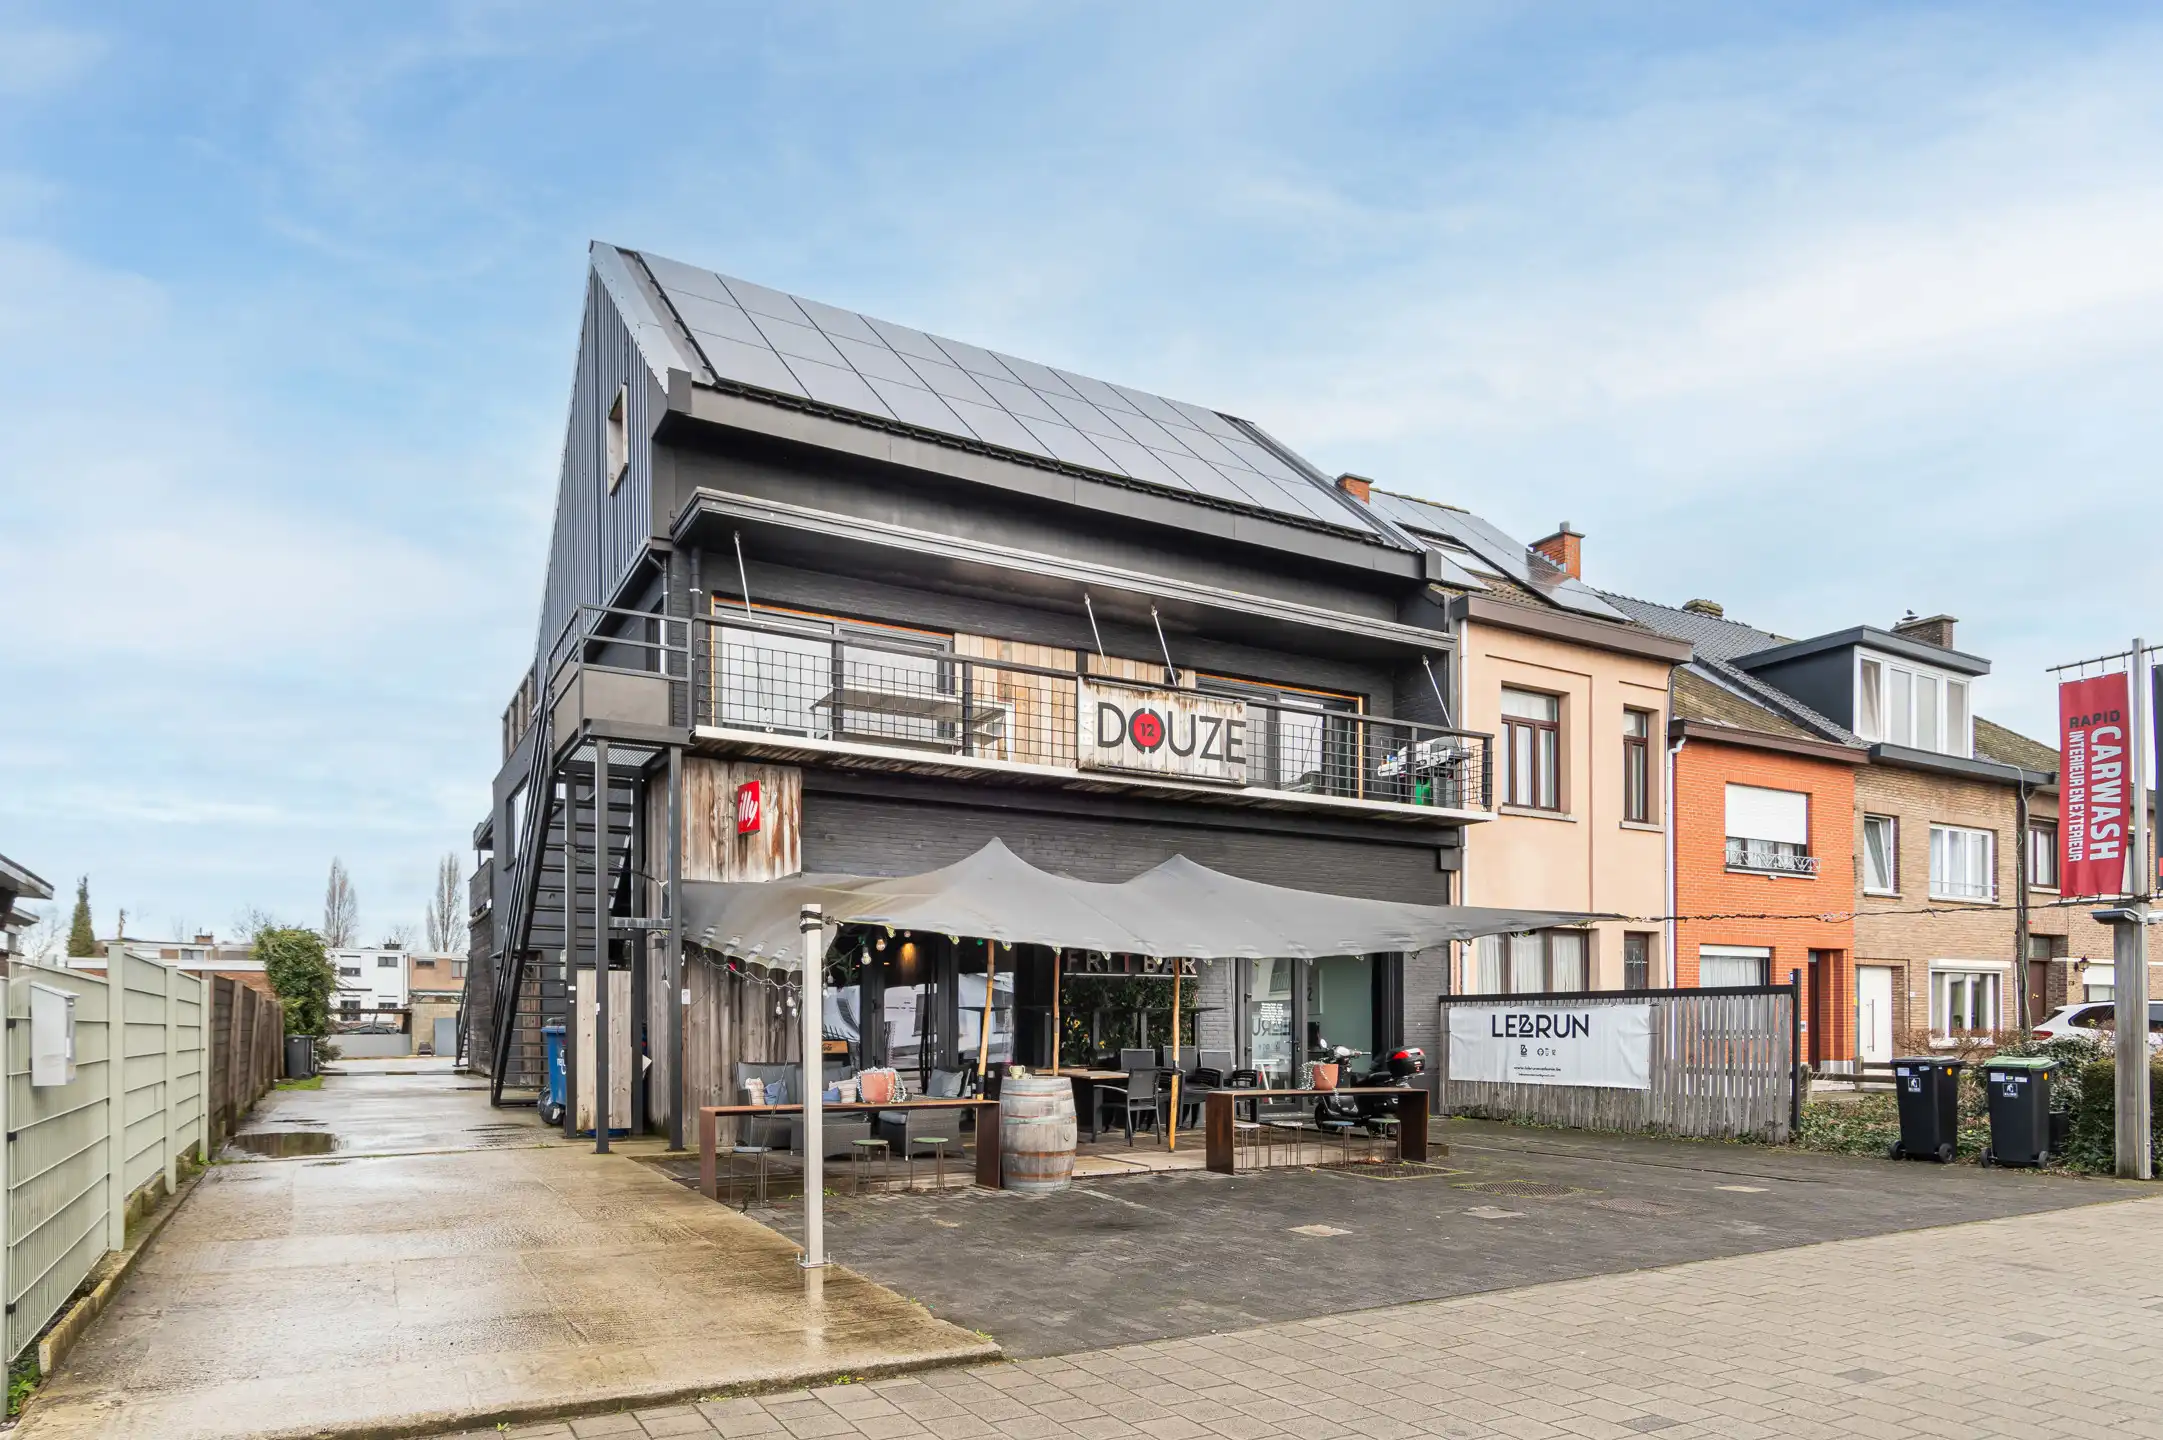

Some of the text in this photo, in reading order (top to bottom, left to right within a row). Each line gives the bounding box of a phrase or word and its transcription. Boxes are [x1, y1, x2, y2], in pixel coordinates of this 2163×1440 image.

[1097, 701, 1247, 764] DOUZE
[1140, 723, 1155, 737] 12
[2069, 710, 2120, 728] RAPID
[738, 790, 758, 827] illy
[2068, 730, 2086, 862] INTERIEUR EN EXTERIEUR
[2090, 726, 2122, 860] CARWASH
[1491, 1014, 1589, 1038] LEBRUN
